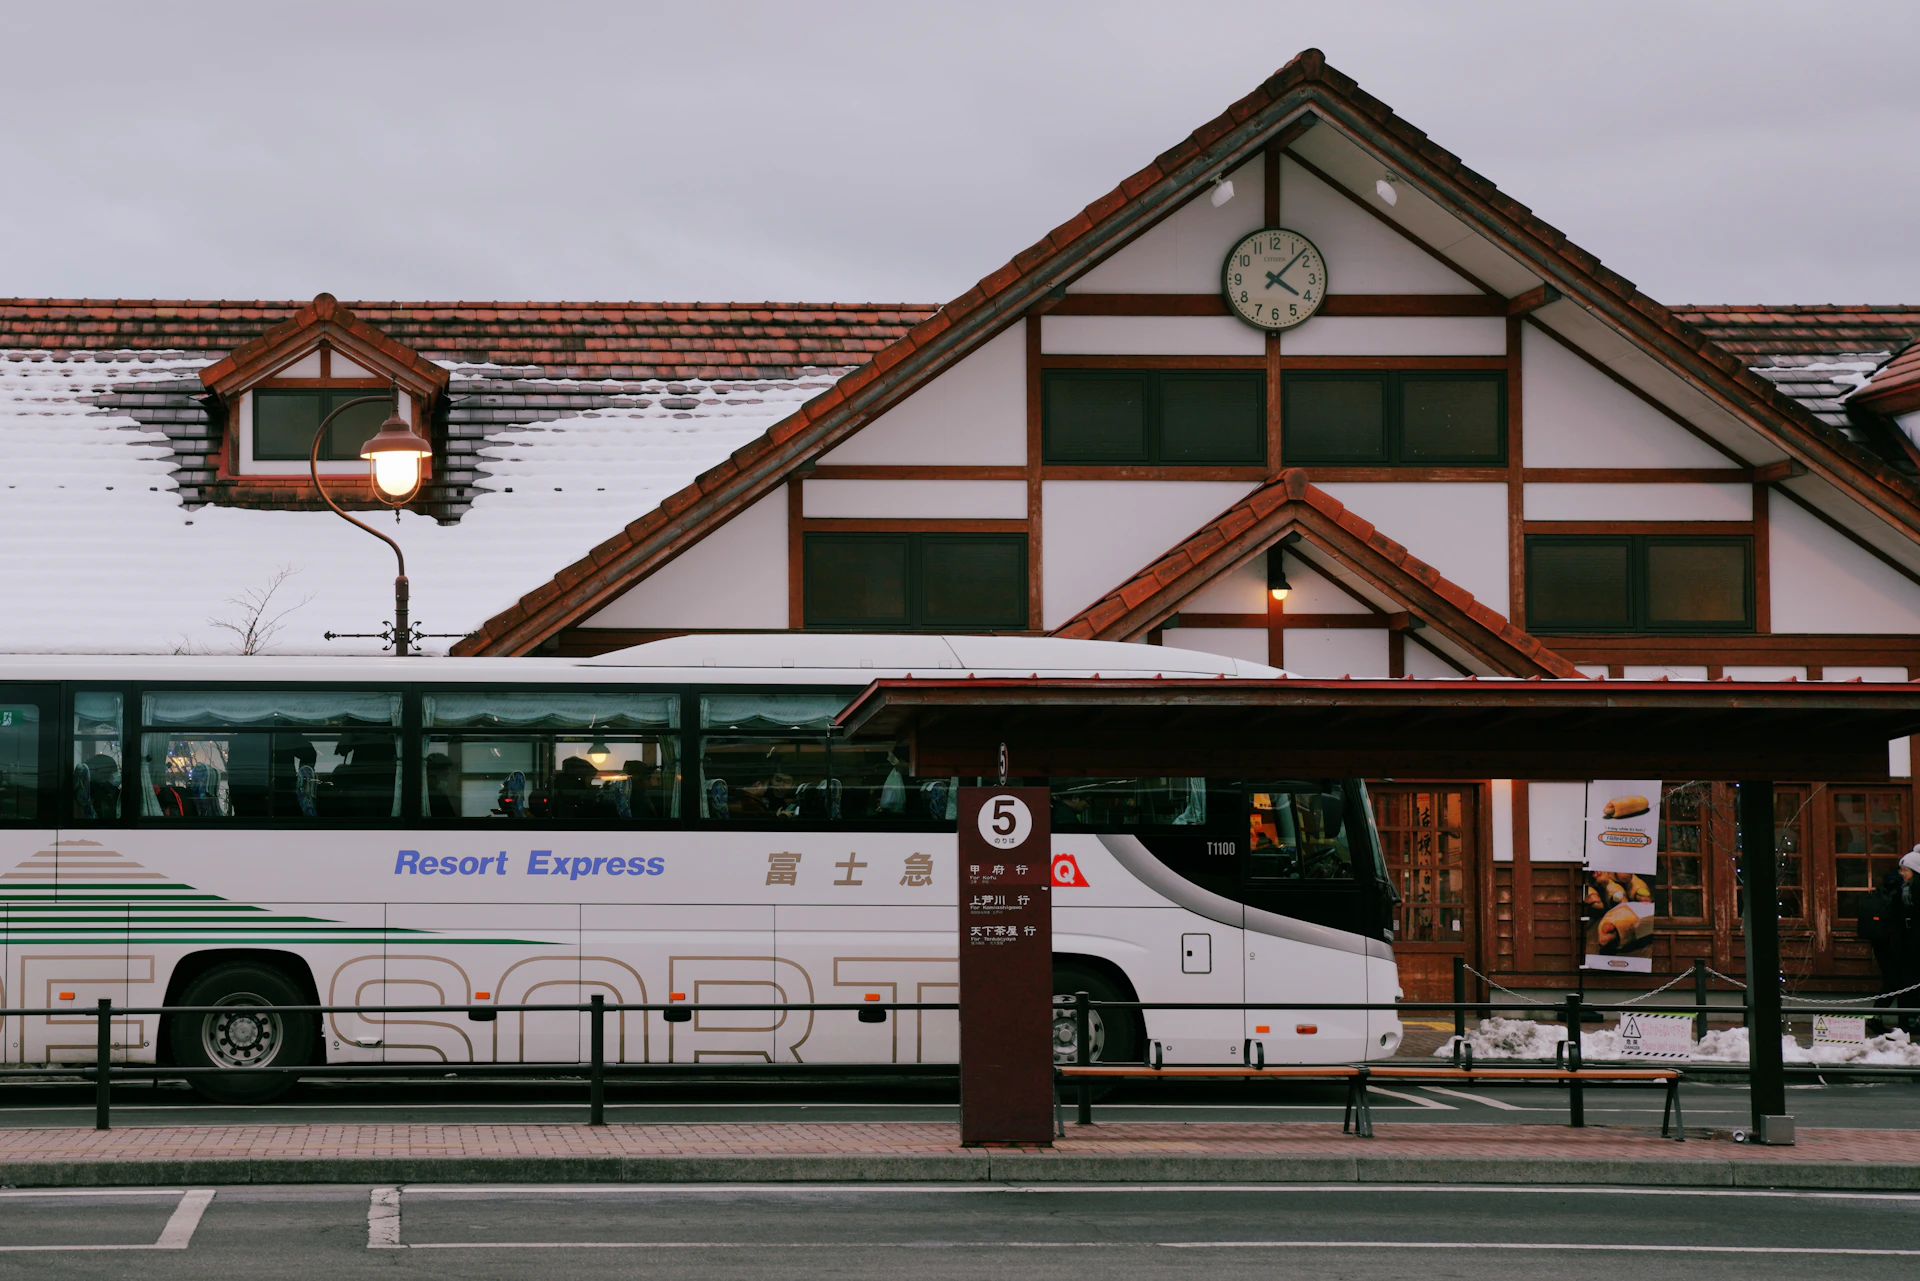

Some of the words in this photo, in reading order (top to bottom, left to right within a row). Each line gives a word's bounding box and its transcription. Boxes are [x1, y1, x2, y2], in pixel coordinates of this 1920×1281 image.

[1254, 242, 1262, 254] 11
[1270, 238, 1281, 250] 12
[1240, 254, 1250, 268] 10
[1302, 255, 1310, 268] 2
[1234, 273, 1242, 286] 9
[1308, 273, 1316, 284] 3
[1240, 291, 1248, 303] 8
[1303, 290, 1312, 302] 4
[1254, 304, 1262, 316] 7
[1272, 308, 1279, 320] 6
[1290, 304, 1297, 316] 5
[1000, 745, 1006, 775] 5
[992, 800, 1017, 836] 5
[1206, 842, 1236, 856] T1100
[394, 850, 508, 876] Resort
[526, 850, 666, 880] Express
[764, 851, 935, 887] 富士急
[1054, 860, 1076, 884] Q
[970, 926, 1018, 936] 天下茶屋
